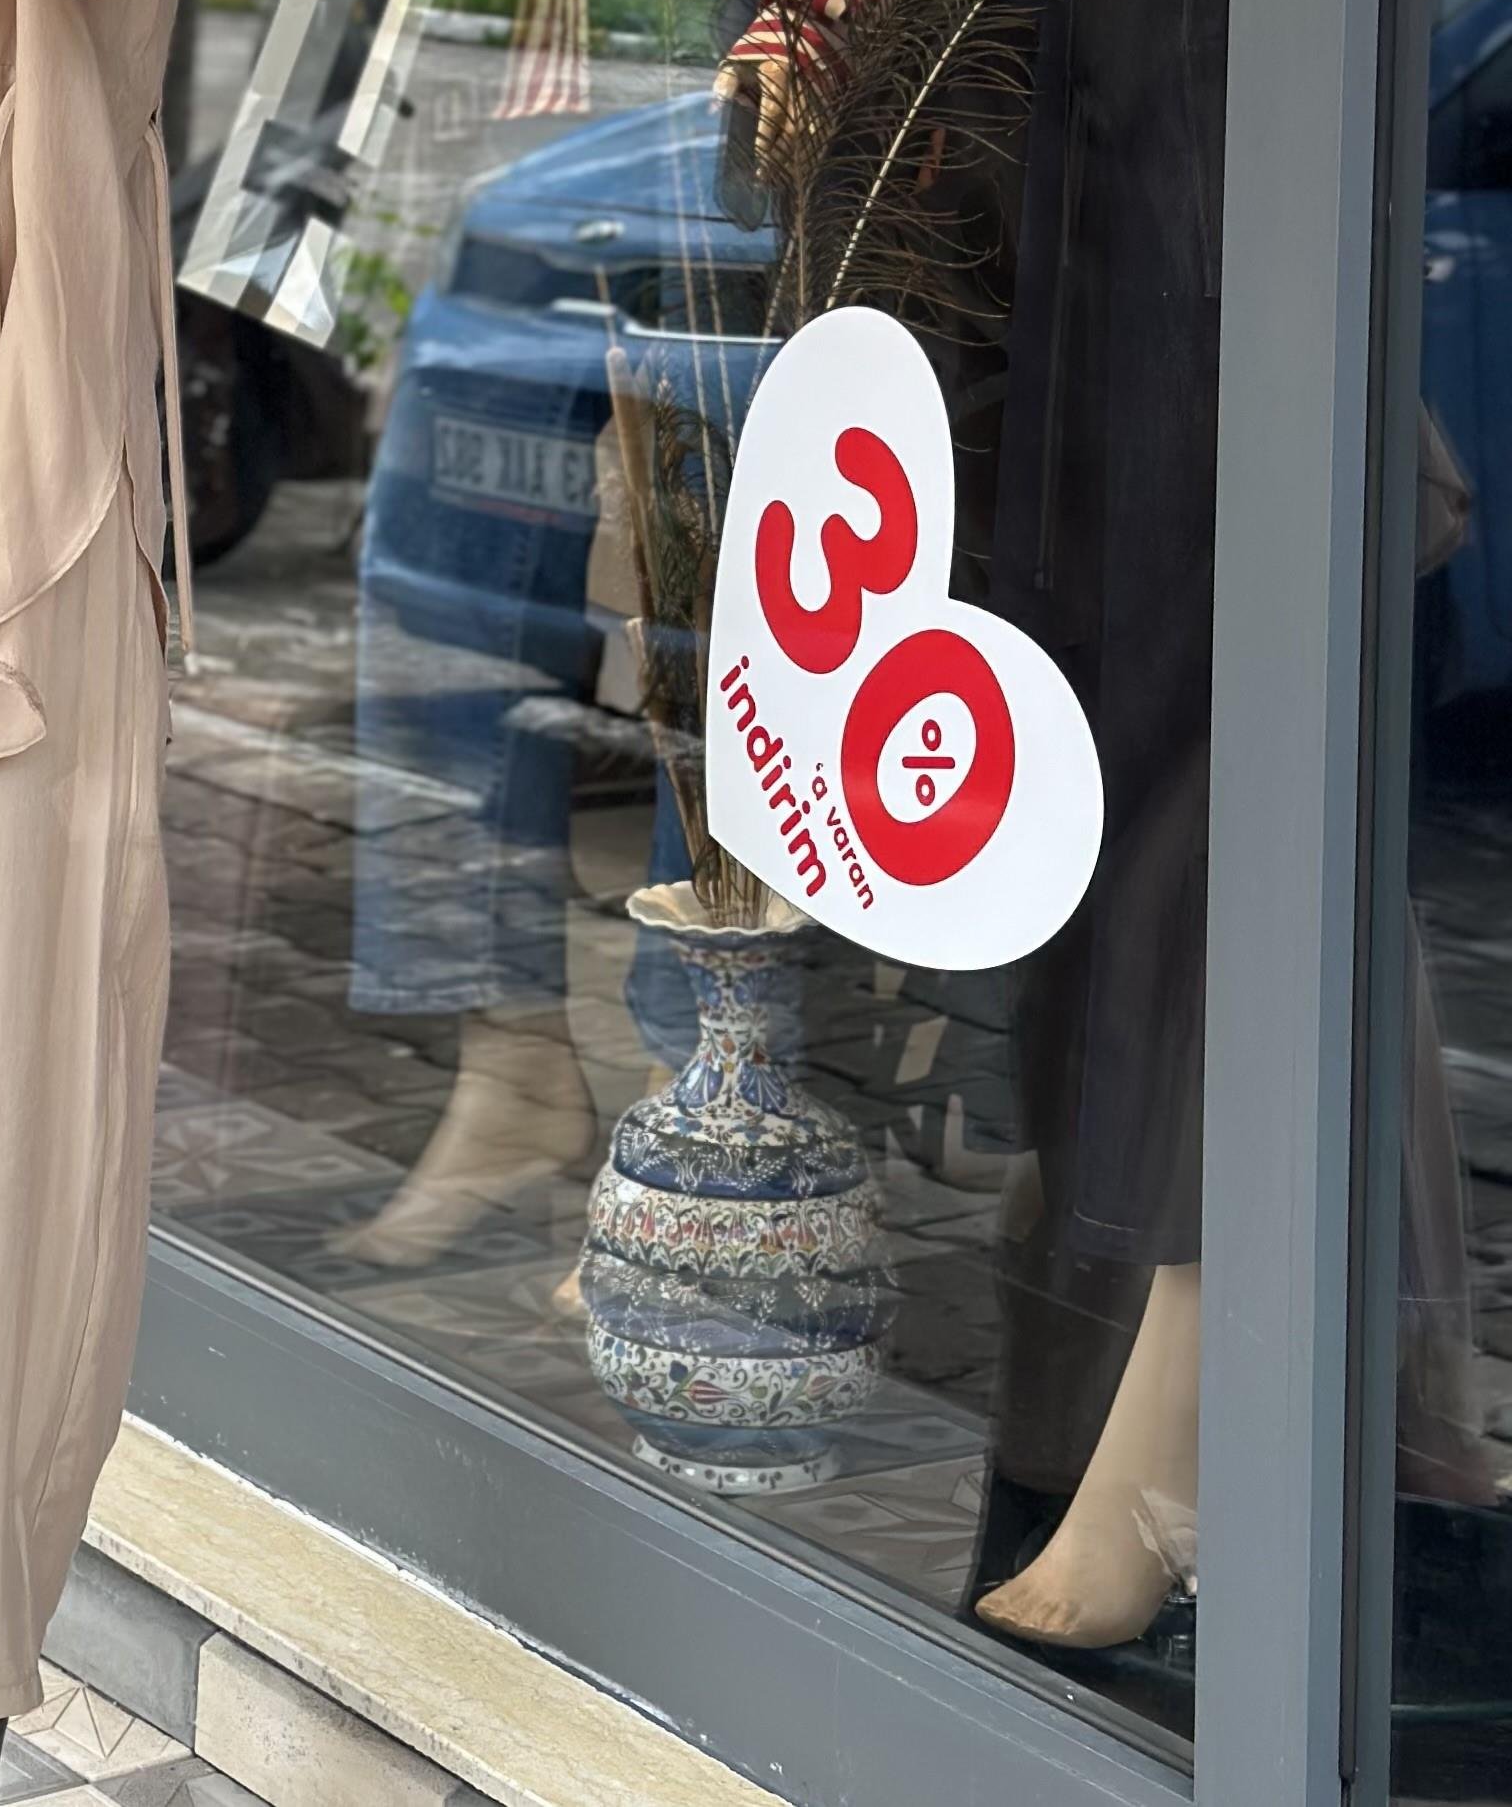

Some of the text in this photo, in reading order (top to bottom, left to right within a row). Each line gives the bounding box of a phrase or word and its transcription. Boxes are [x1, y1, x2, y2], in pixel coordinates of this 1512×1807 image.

[719, 654, 827, 898] indirim
[755, 426, 1016, 886] 30
[826, 805, 875, 910] varan
